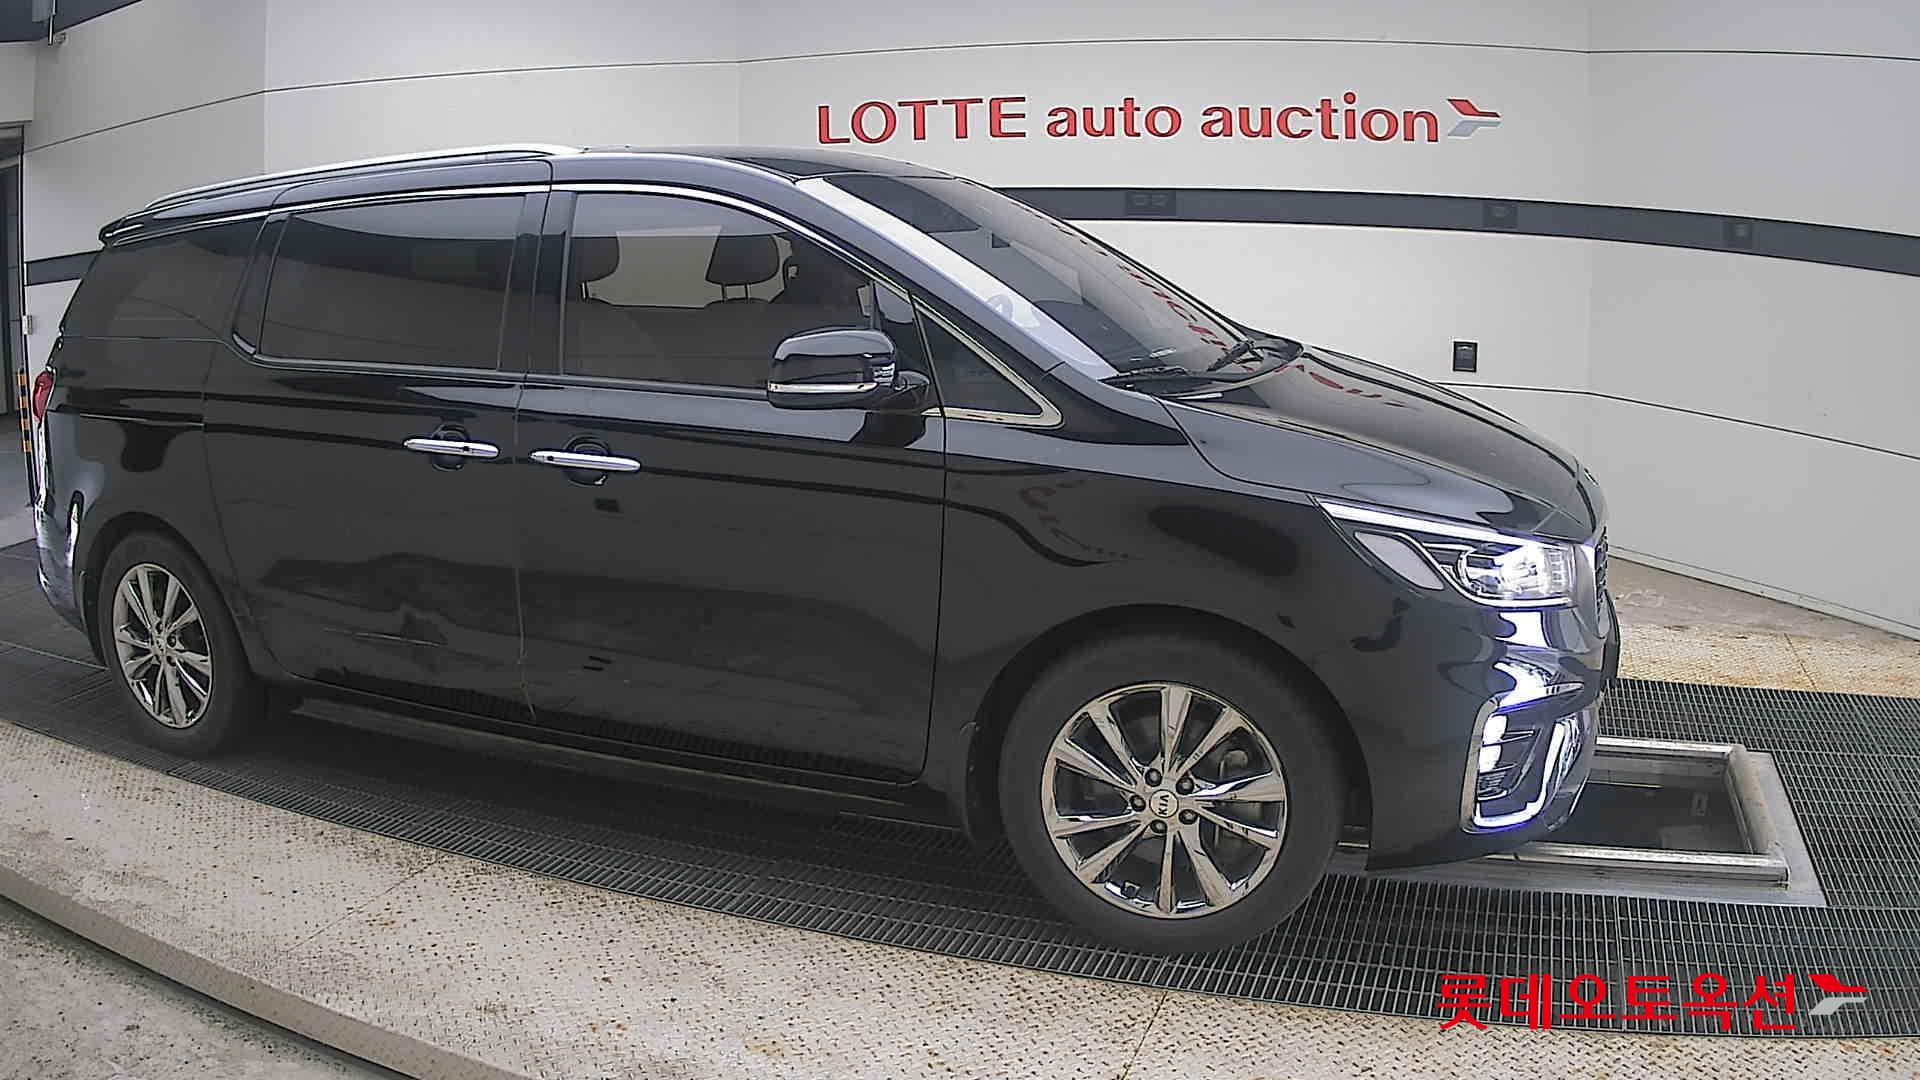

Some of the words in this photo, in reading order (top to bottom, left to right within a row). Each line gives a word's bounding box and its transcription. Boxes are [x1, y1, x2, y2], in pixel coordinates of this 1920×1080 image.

[818, 97, 1024, 143] LOTTE
[1047, 98, 1182, 138] auto
[1201, 91, 1439, 142] auction
[1157, 794, 1170, 816] KIA
